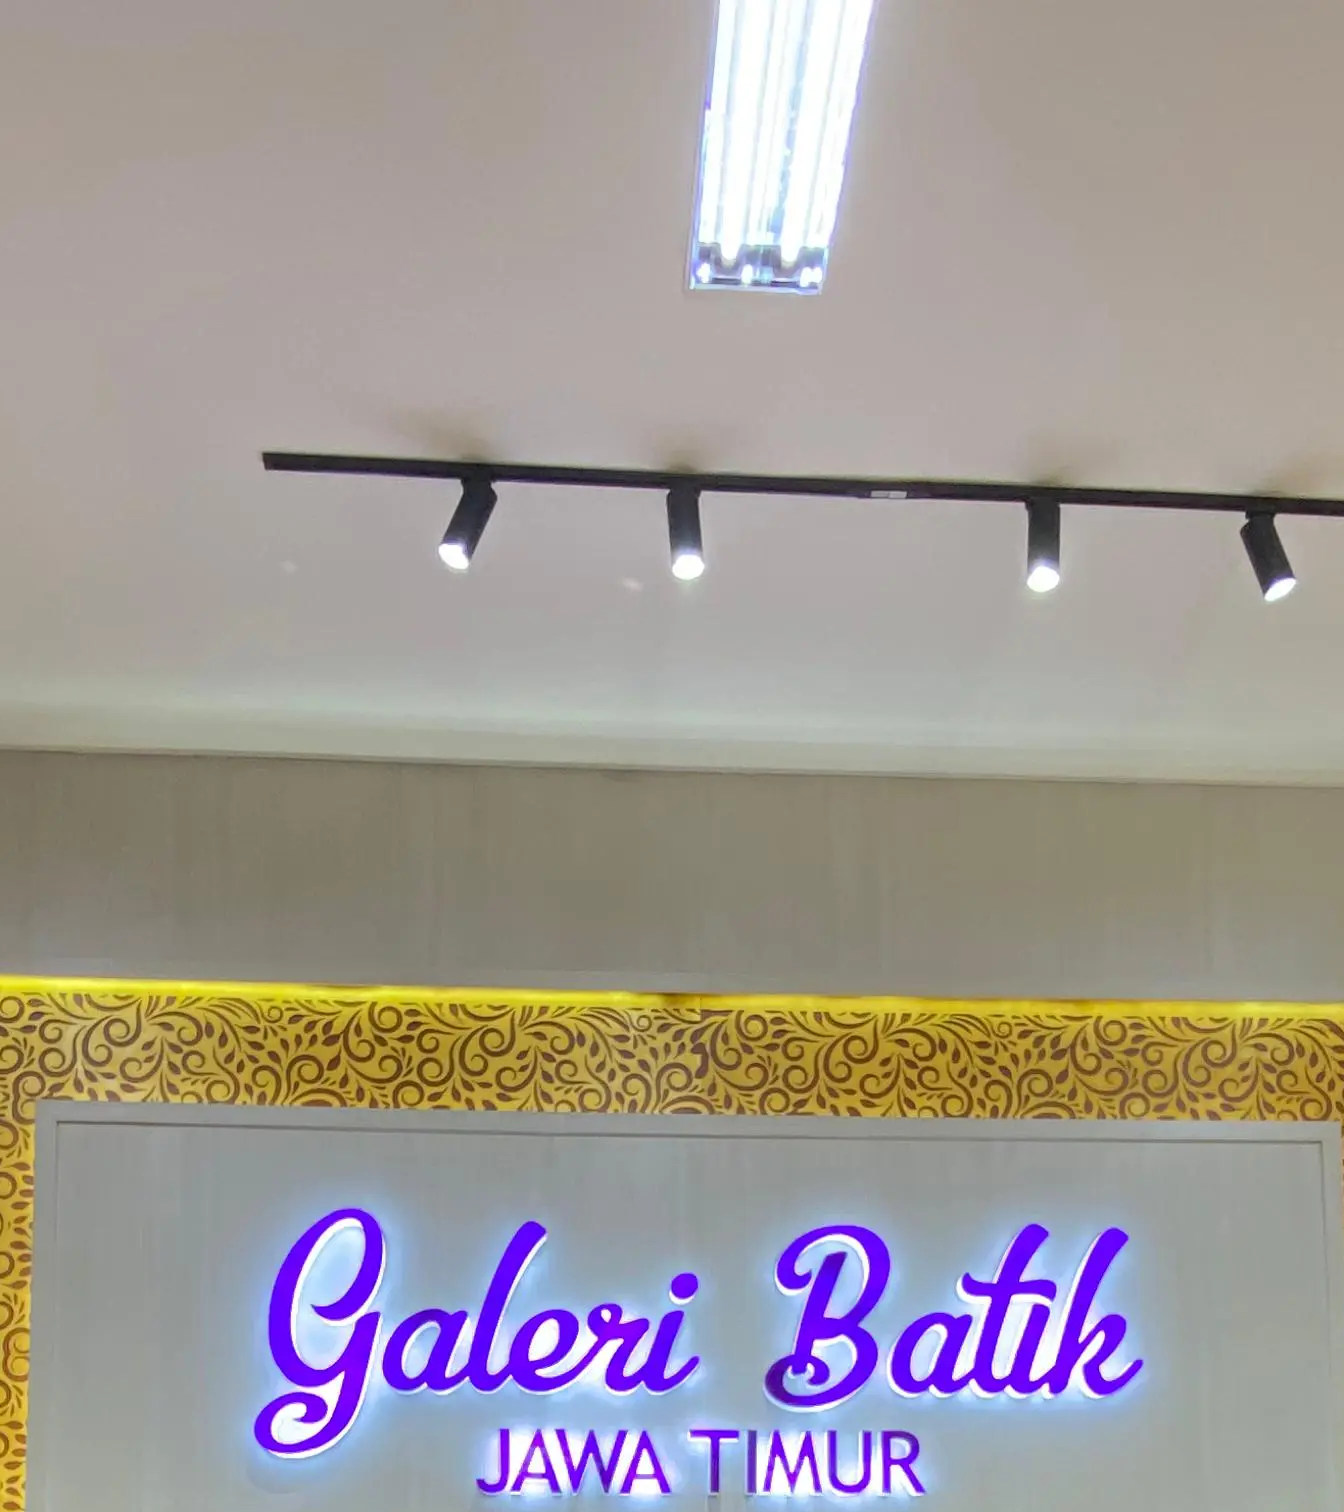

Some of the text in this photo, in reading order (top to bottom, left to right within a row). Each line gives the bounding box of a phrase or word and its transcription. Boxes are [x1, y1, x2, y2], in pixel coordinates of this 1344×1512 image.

[252, 1207, 1143, 1458] Galeri Batik
[475, 1428, 926, 1496] JAWA TIMUR
